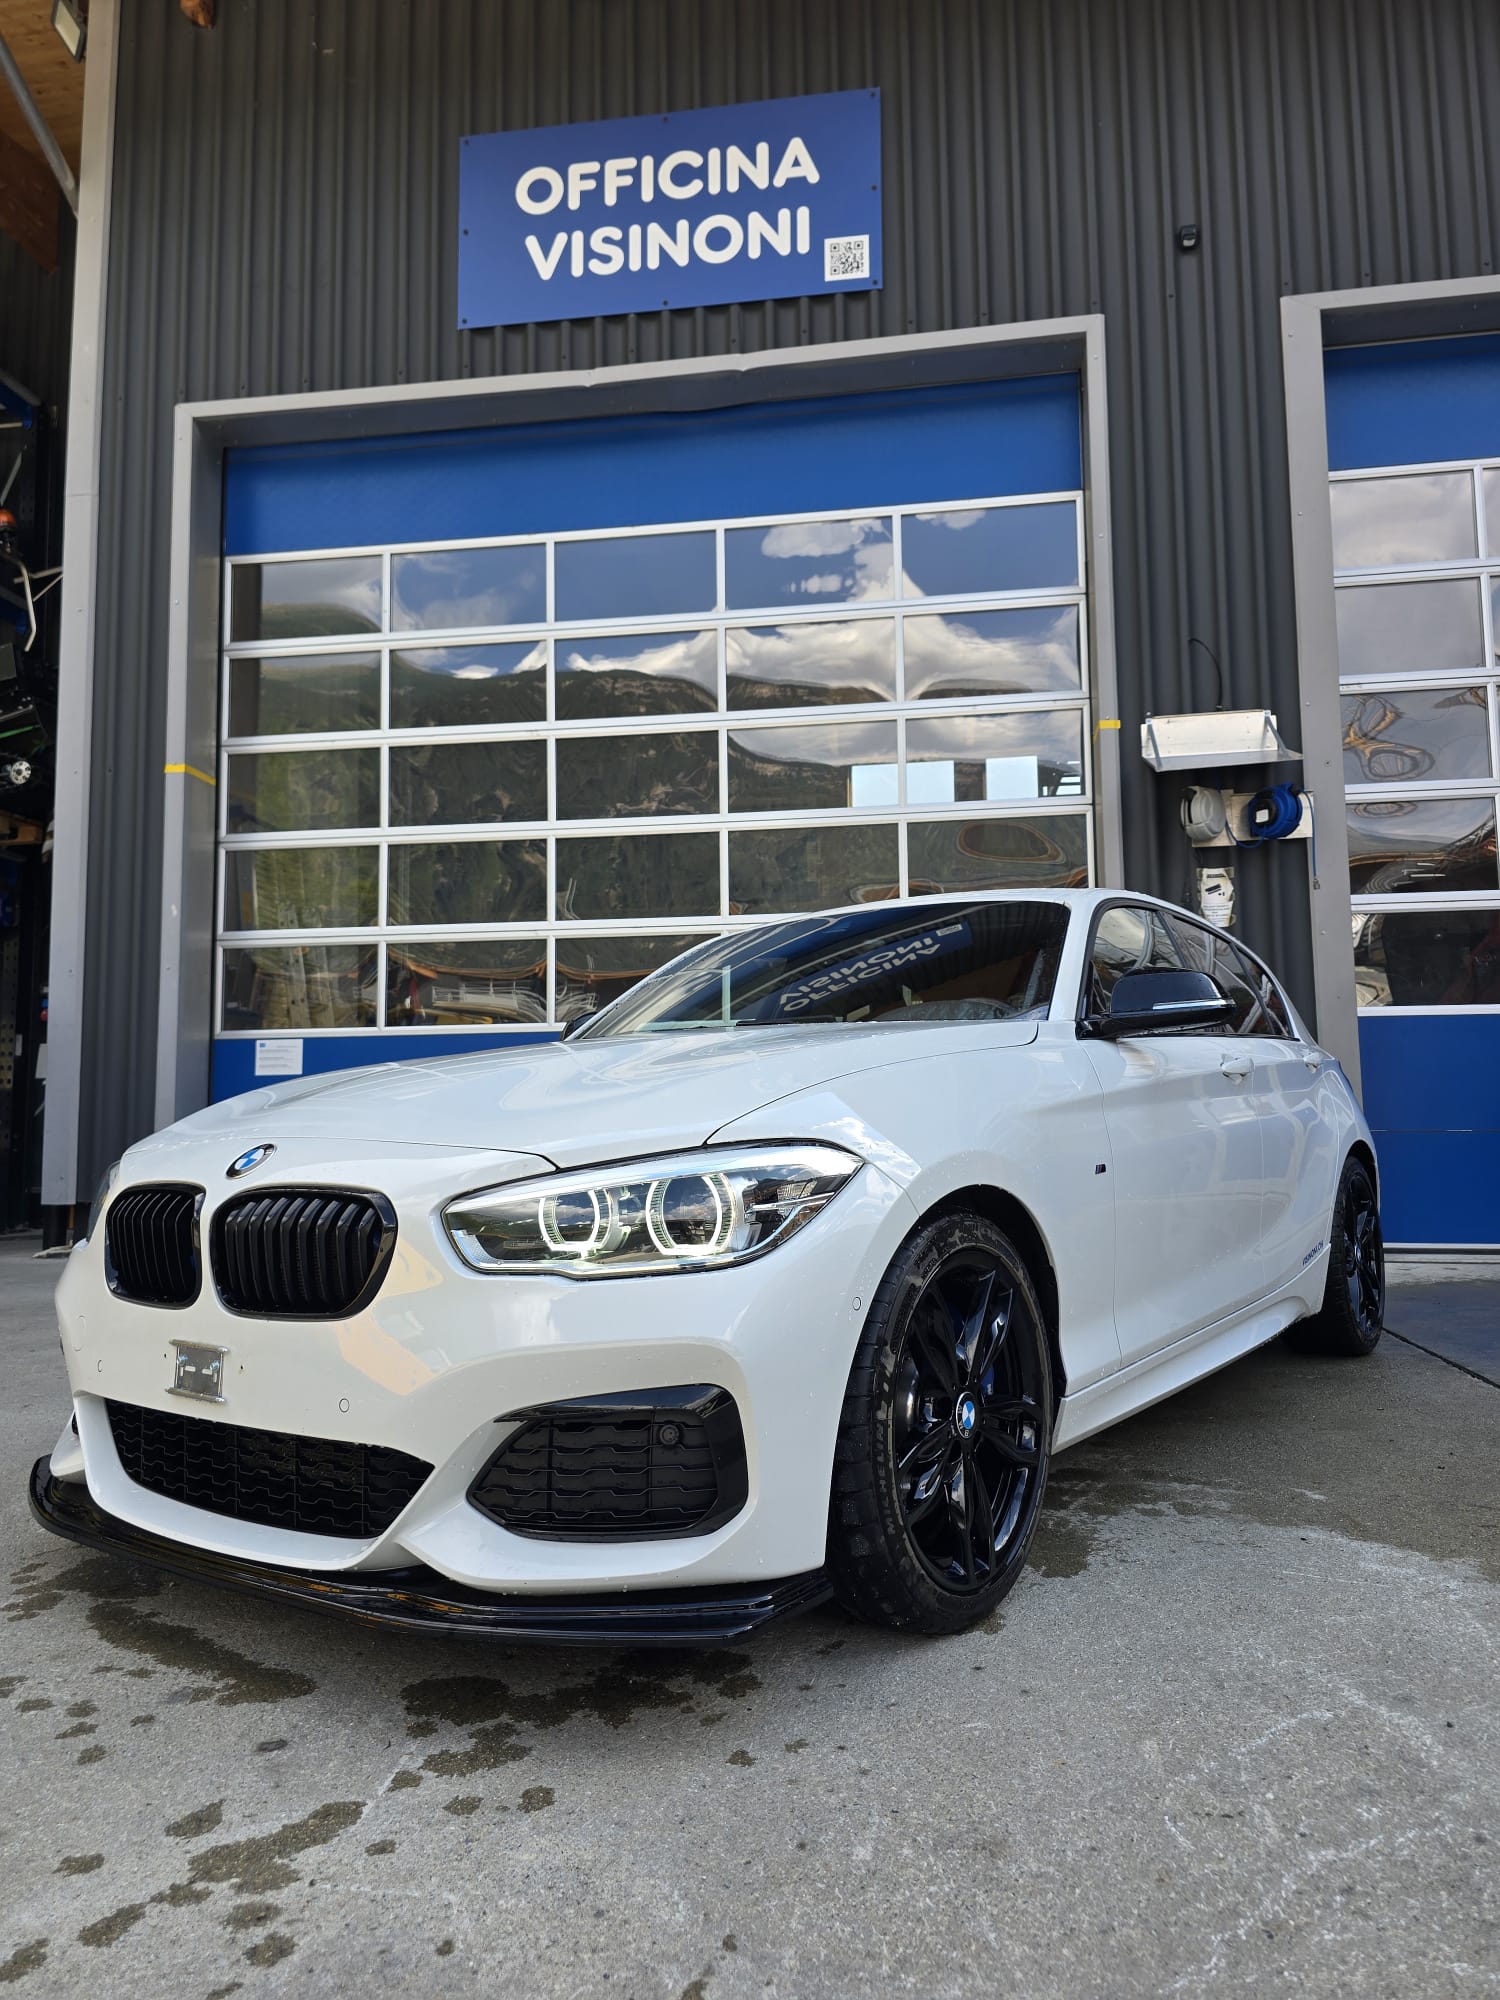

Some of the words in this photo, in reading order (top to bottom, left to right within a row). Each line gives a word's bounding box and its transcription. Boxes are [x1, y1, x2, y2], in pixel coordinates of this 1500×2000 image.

[514, 136, 820, 216] OFFICINA
[524, 205, 810, 281] VISINONI
[875, 1422, 897, 1535] MICHELIN
